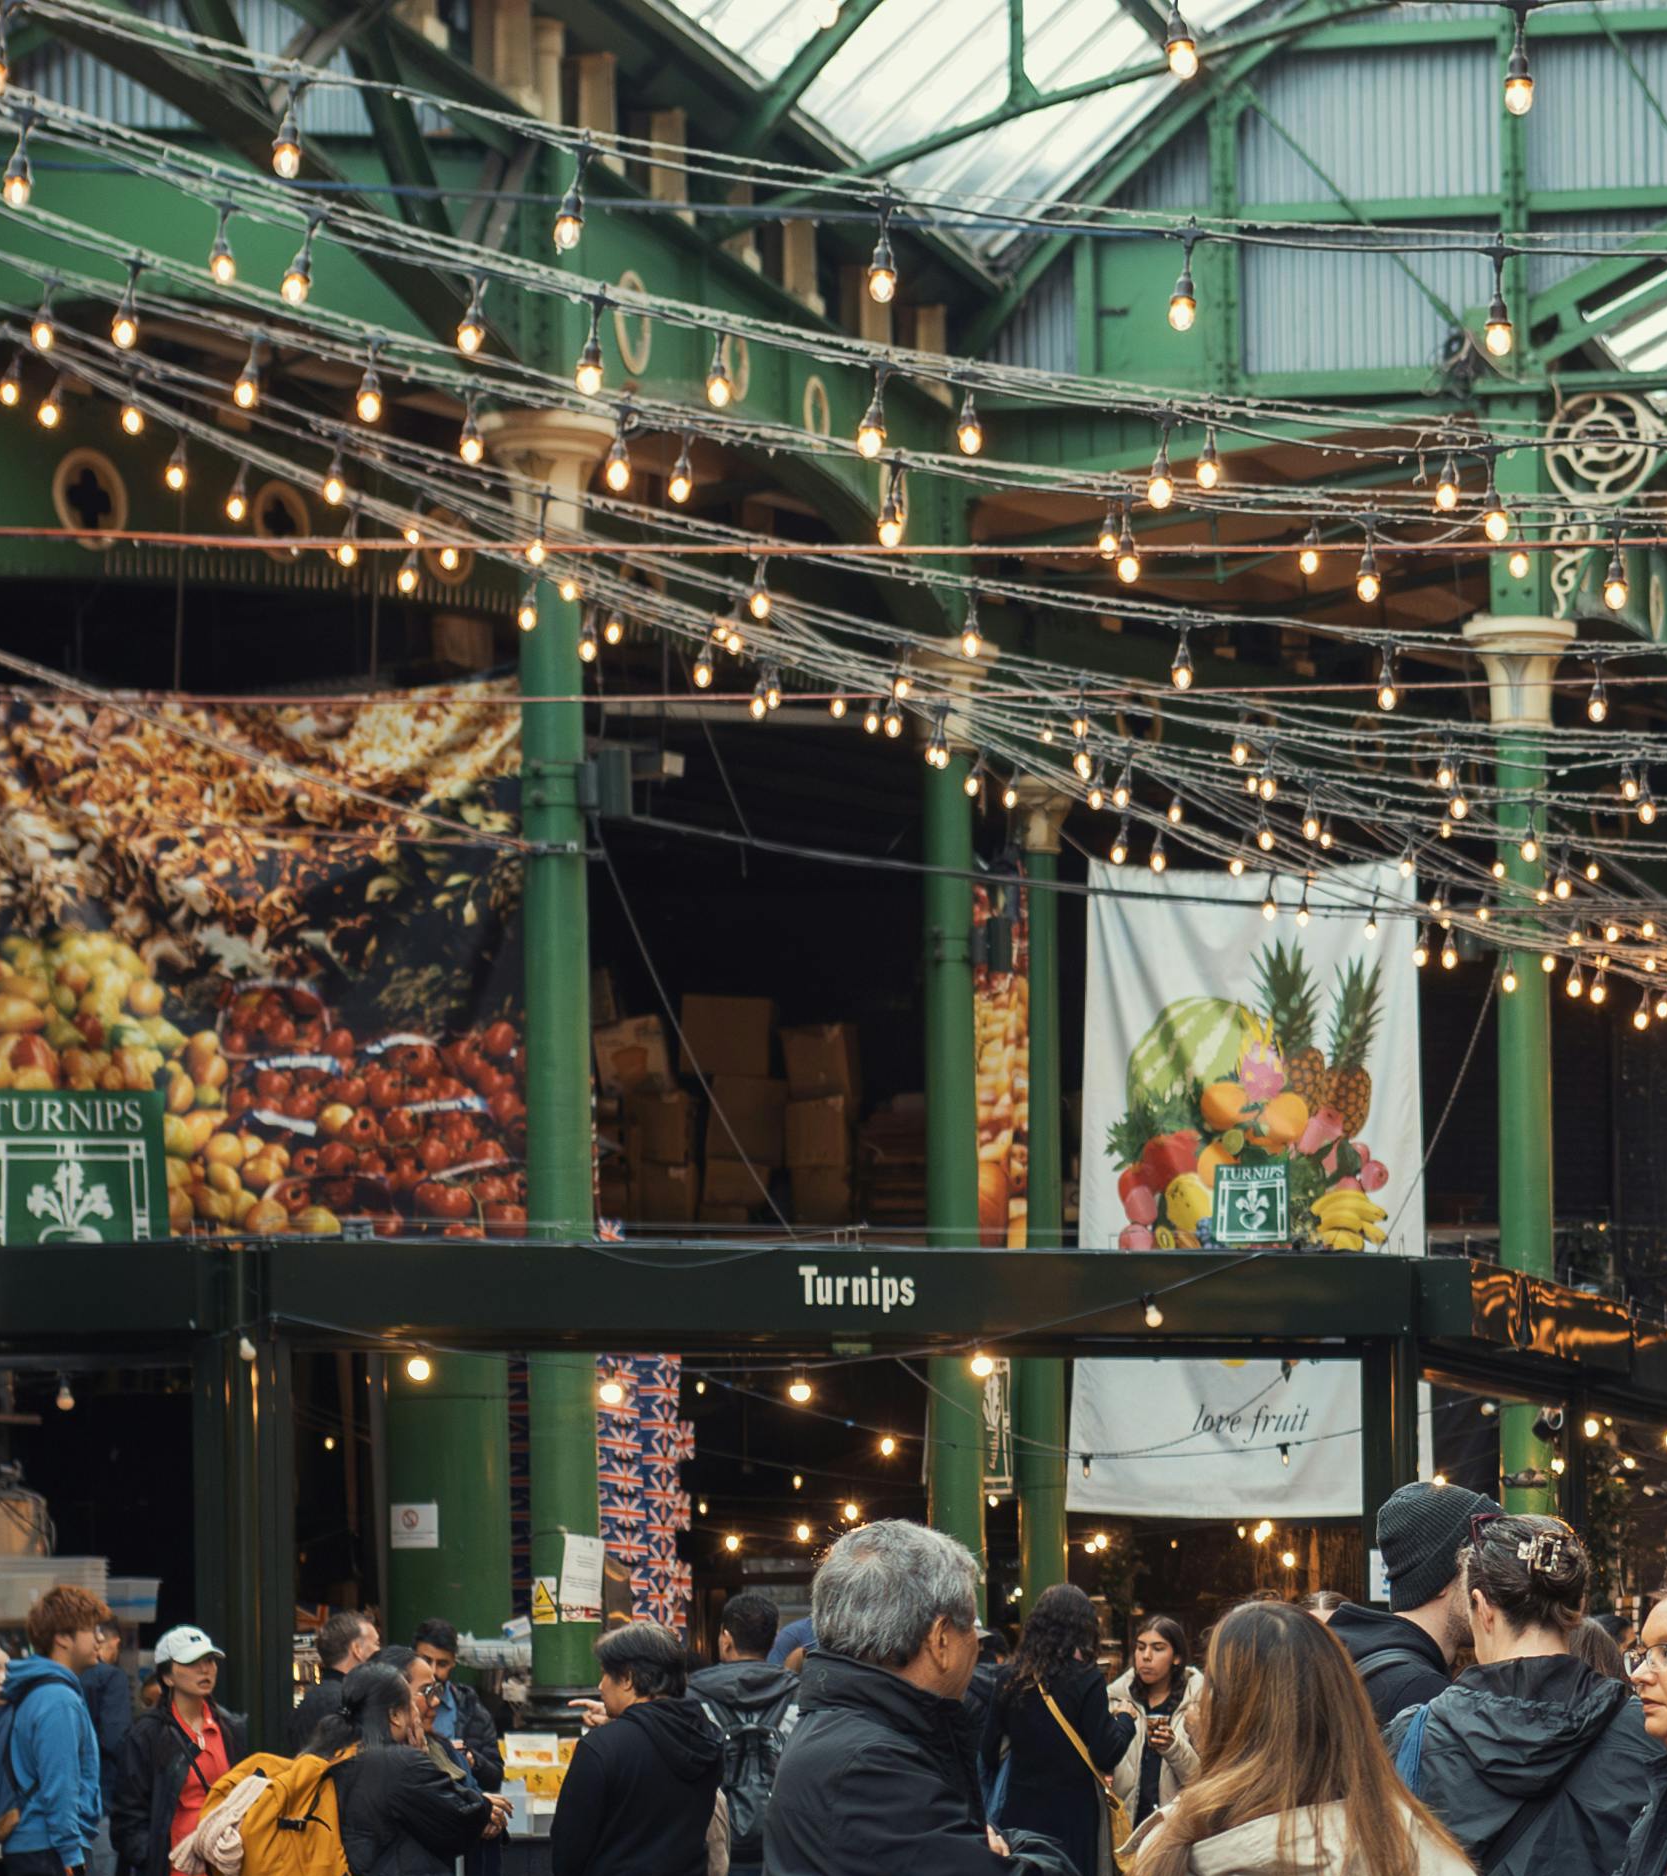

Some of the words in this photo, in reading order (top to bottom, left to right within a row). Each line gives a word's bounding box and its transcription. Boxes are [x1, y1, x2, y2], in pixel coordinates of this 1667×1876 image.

[1218, 1164, 1286, 1181] TURNIPS
[798, 1264, 916, 1314] Turnips
[1192, 1402, 1242, 1434] love
[1242, 1403, 1311, 1444] fruit
